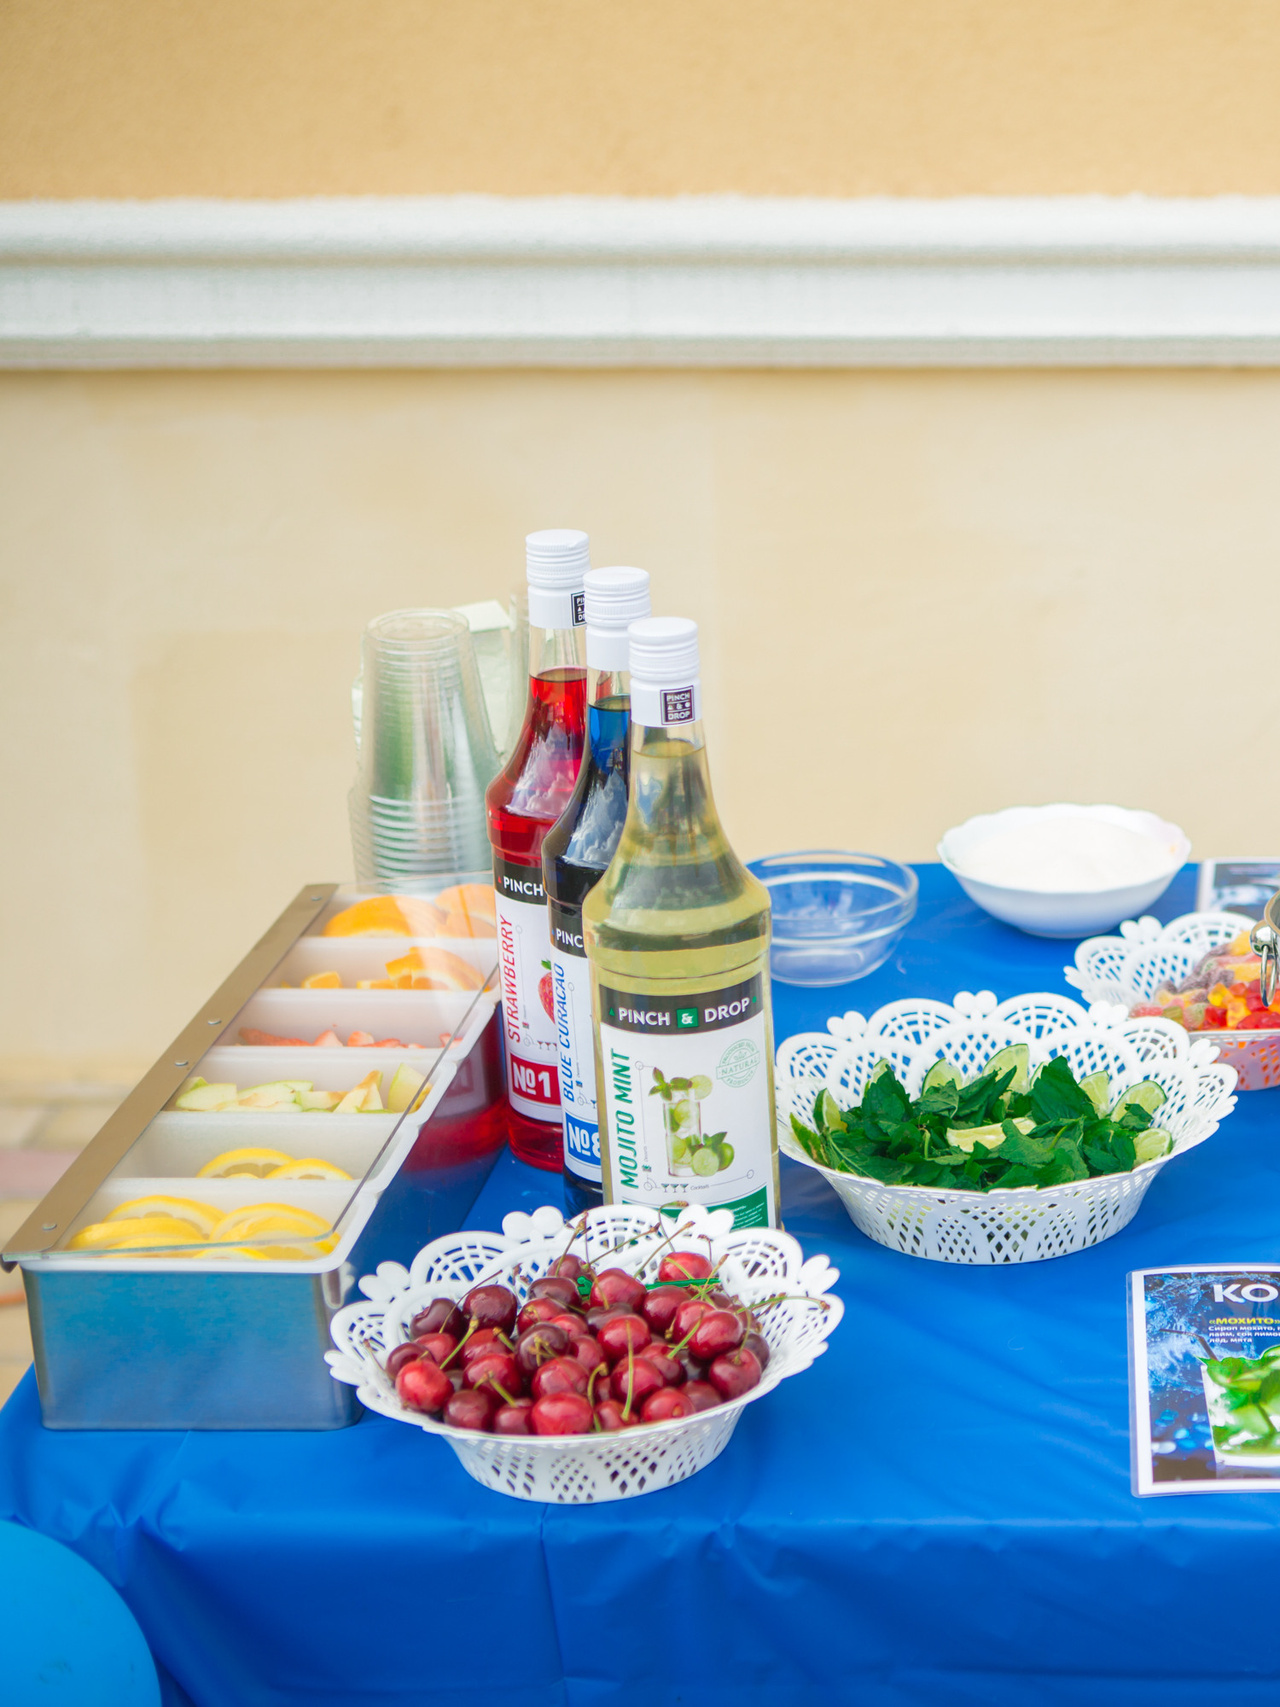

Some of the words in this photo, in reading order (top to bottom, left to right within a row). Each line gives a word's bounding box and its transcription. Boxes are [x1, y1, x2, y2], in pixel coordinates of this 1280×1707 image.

[666, 692, 691, 702] PINCH
[667, 711, 691, 720] DROP
[503, 875, 544, 897] PINCH
[499, 914, 521, 1043] STRAWBERRY
[554, 962, 571, 1049] CURACAO
[618, 1007, 671, 1026] PINCH
[681, 1013, 693, 1024] &
[704, 997, 750, 1023] DROP
[560, 1052, 575, 1103] BLUE
[611, 1048, 633, 1104] MINT
[615, 1109, 639, 1189] MOJITO
[1209, 1317, 1280, 1325] «МОХИТО»
